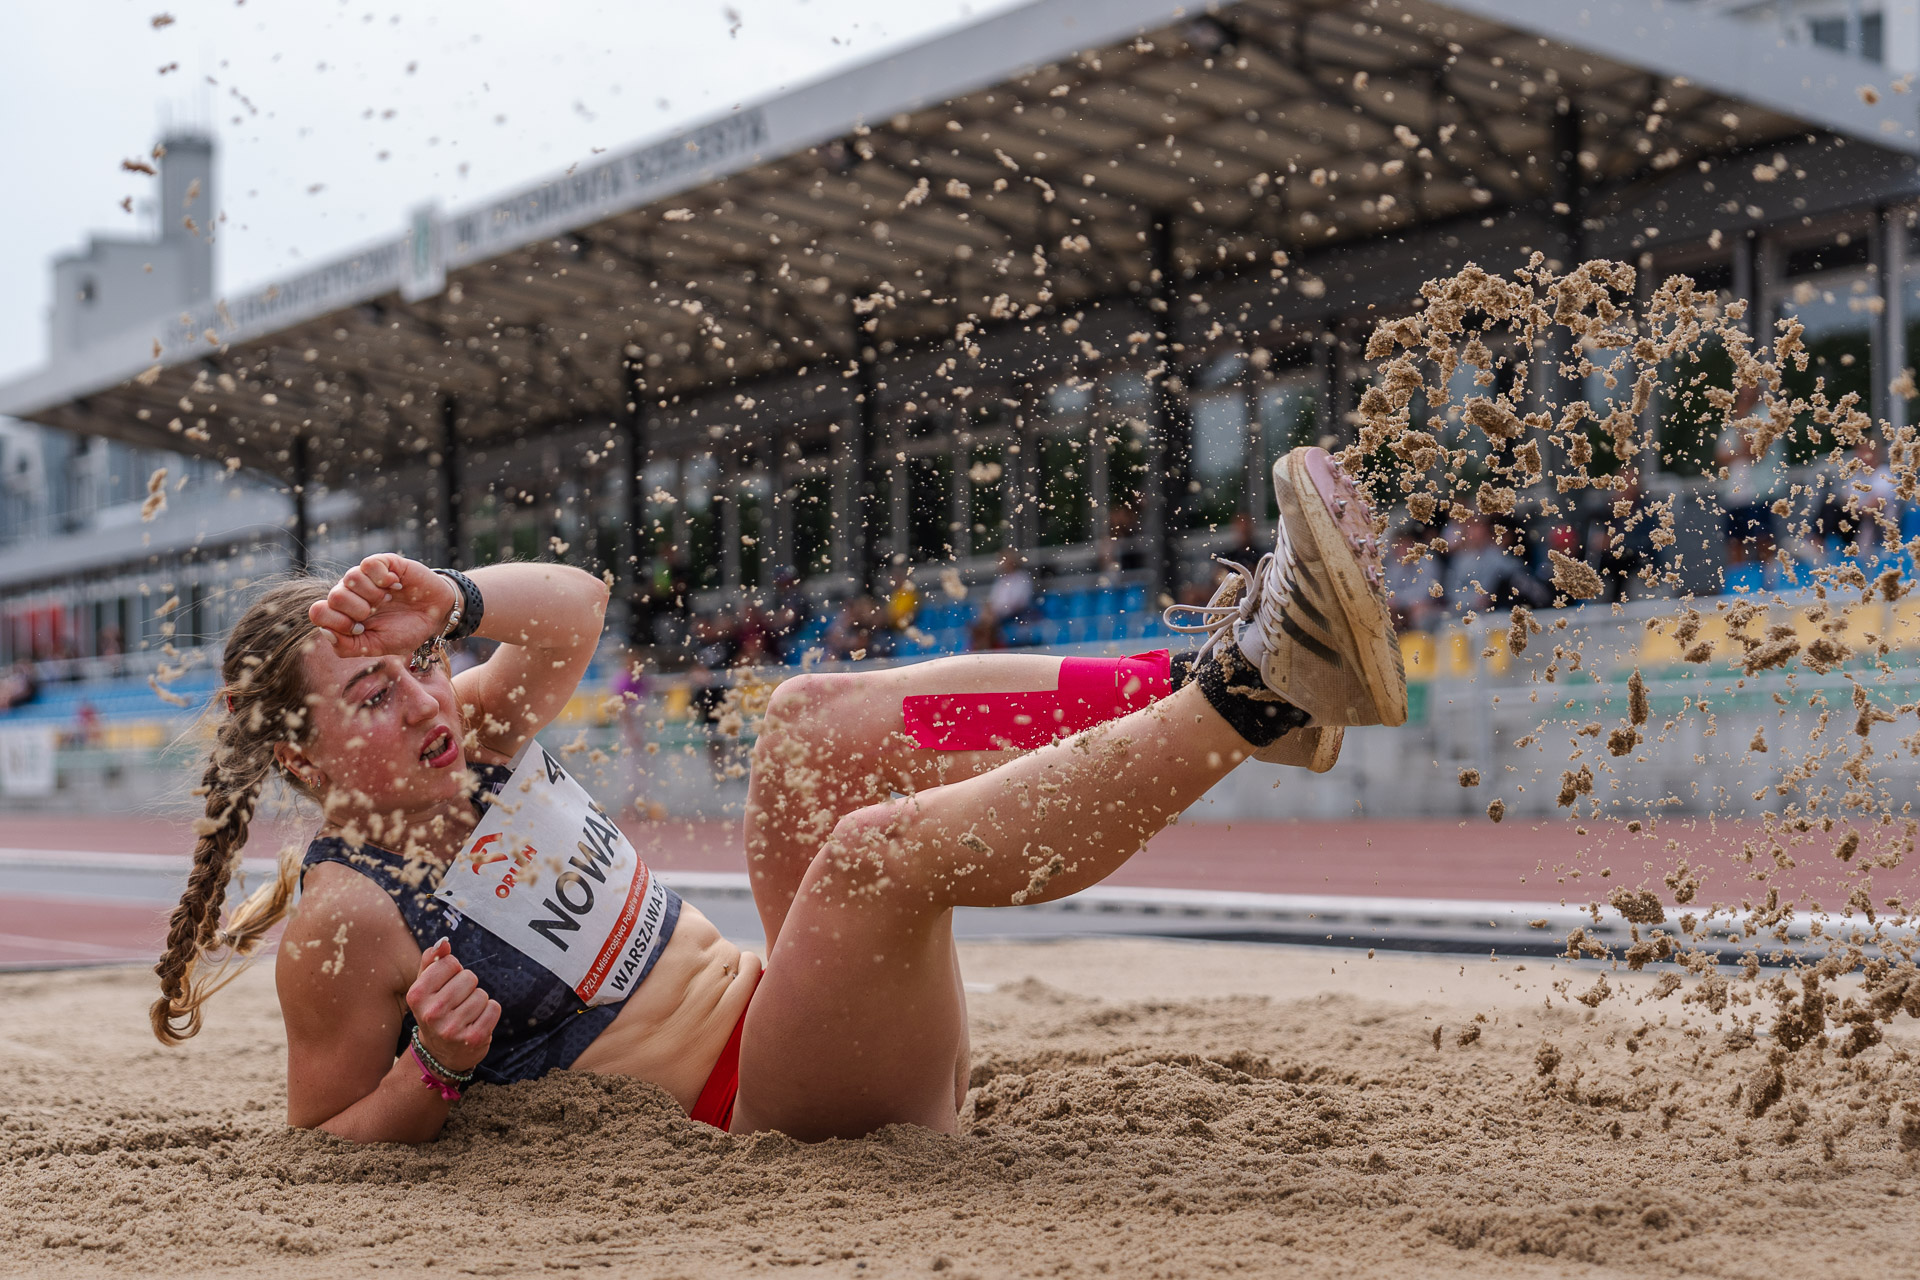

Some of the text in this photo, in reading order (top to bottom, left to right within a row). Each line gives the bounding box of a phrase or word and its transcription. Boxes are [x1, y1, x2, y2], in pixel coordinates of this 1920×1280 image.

[582, 972, 600, 995] PZLA
[596, 924, 627, 974] Mistrzostwa
[622, 901, 637, 925] Polski
[610, 896, 663, 992] WARSZAWA
